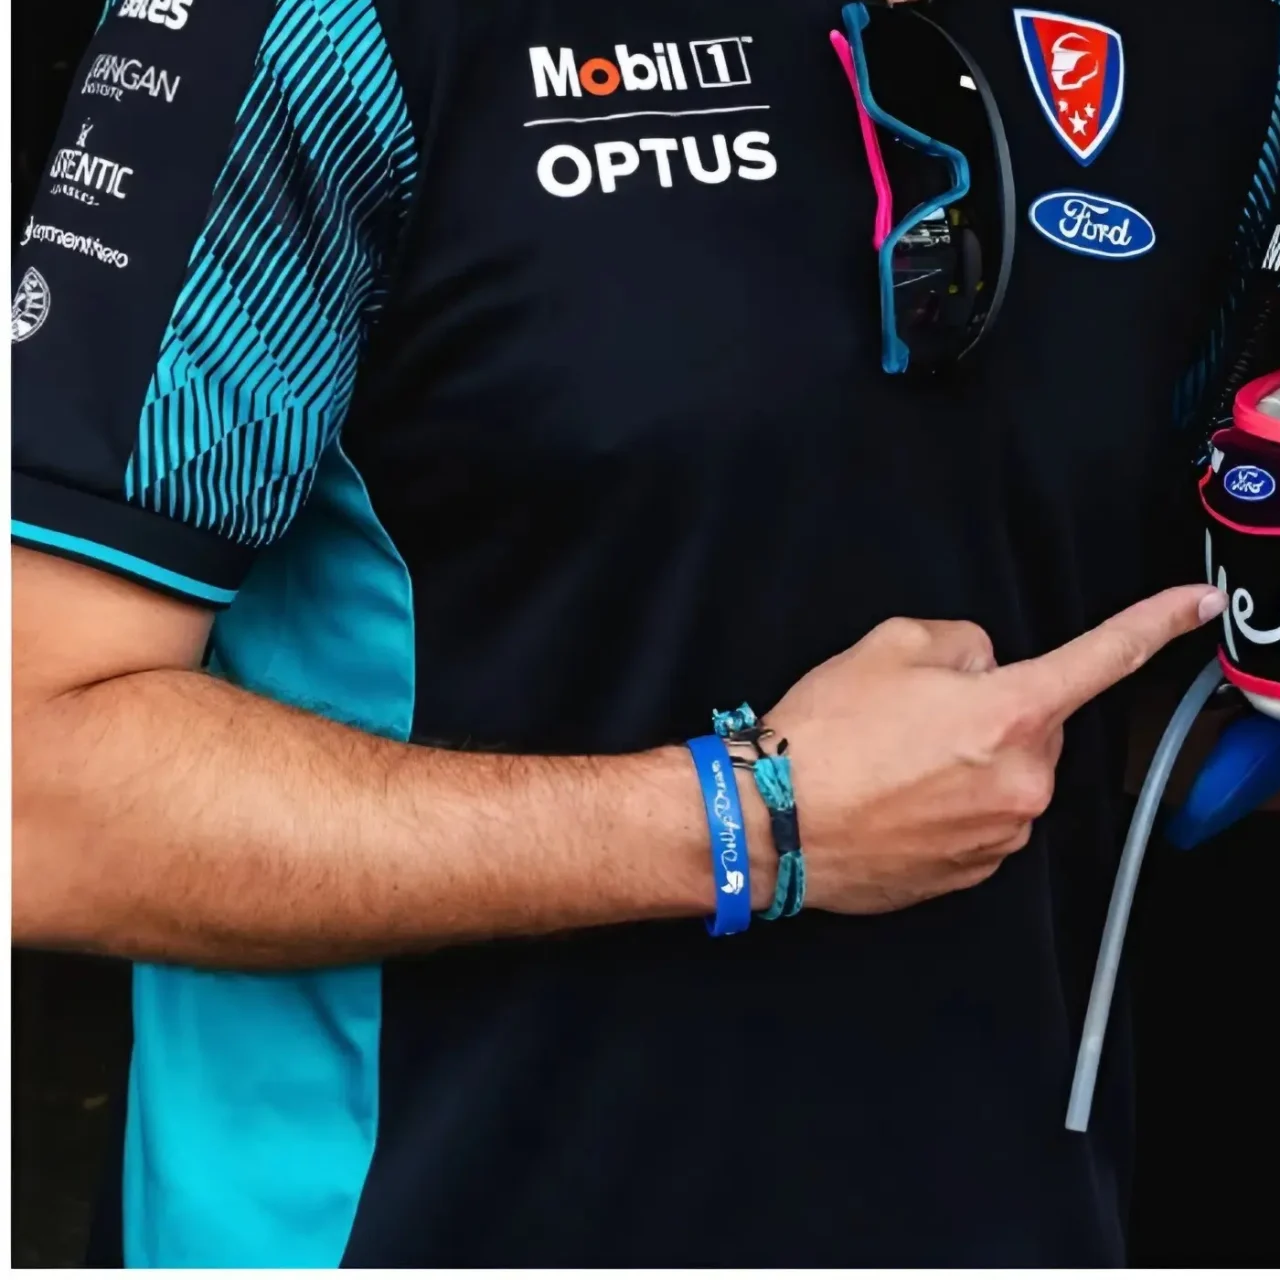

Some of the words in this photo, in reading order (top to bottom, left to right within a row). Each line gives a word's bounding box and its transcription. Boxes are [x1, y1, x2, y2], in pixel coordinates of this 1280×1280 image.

[529, 41, 688, 98] Mobil
[536, 130, 778, 198] OPTUS
[1058, 198, 1133, 247] Ford
